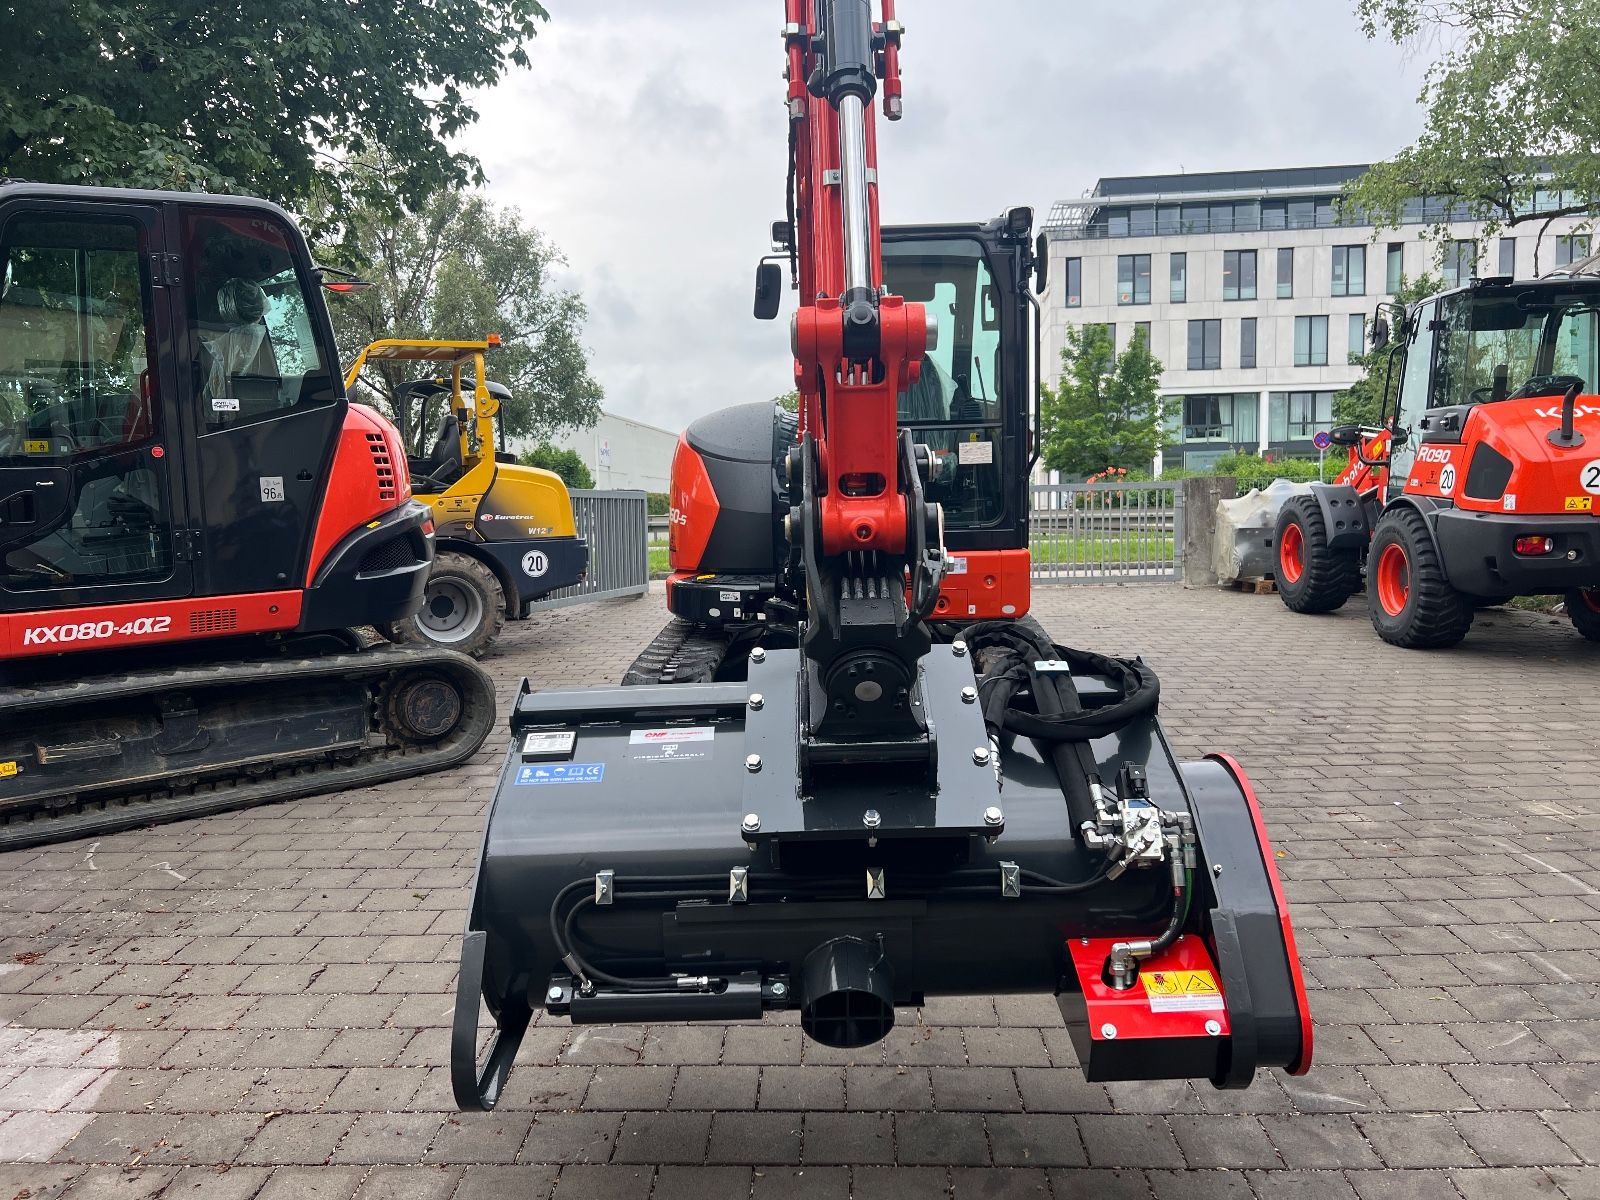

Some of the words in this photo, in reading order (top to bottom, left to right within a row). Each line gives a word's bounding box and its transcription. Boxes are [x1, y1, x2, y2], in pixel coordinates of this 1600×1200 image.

[1416, 446, 1451, 464] R090
[1341, 460, 1364, 486] bota
[1441, 469, 1454, 489] 20
[263, 488, 276, 499] 96
[527, 556, 543, 571] 20
